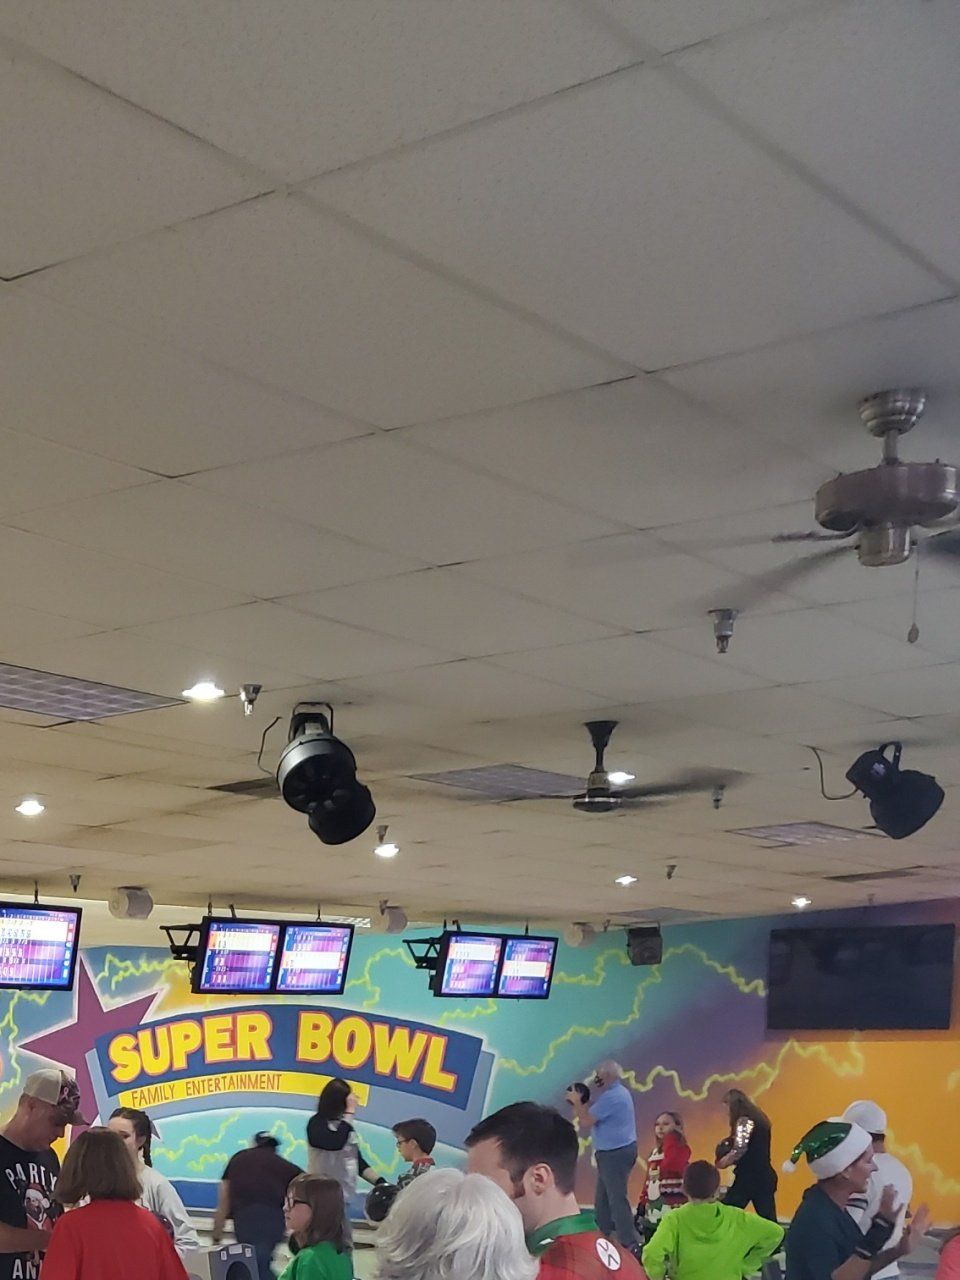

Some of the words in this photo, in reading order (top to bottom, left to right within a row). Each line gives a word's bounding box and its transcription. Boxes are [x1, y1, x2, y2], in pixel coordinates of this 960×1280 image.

[108, 1010, 273, 1084] SUPER
[296, 1010, 461, 1093] BOWL
[131, 1087, 175, 1108] FAMILY
[184, 1073, 283, 1095] ENTERTAINMENT
[5, 1162, 57, 1192] PARTY
